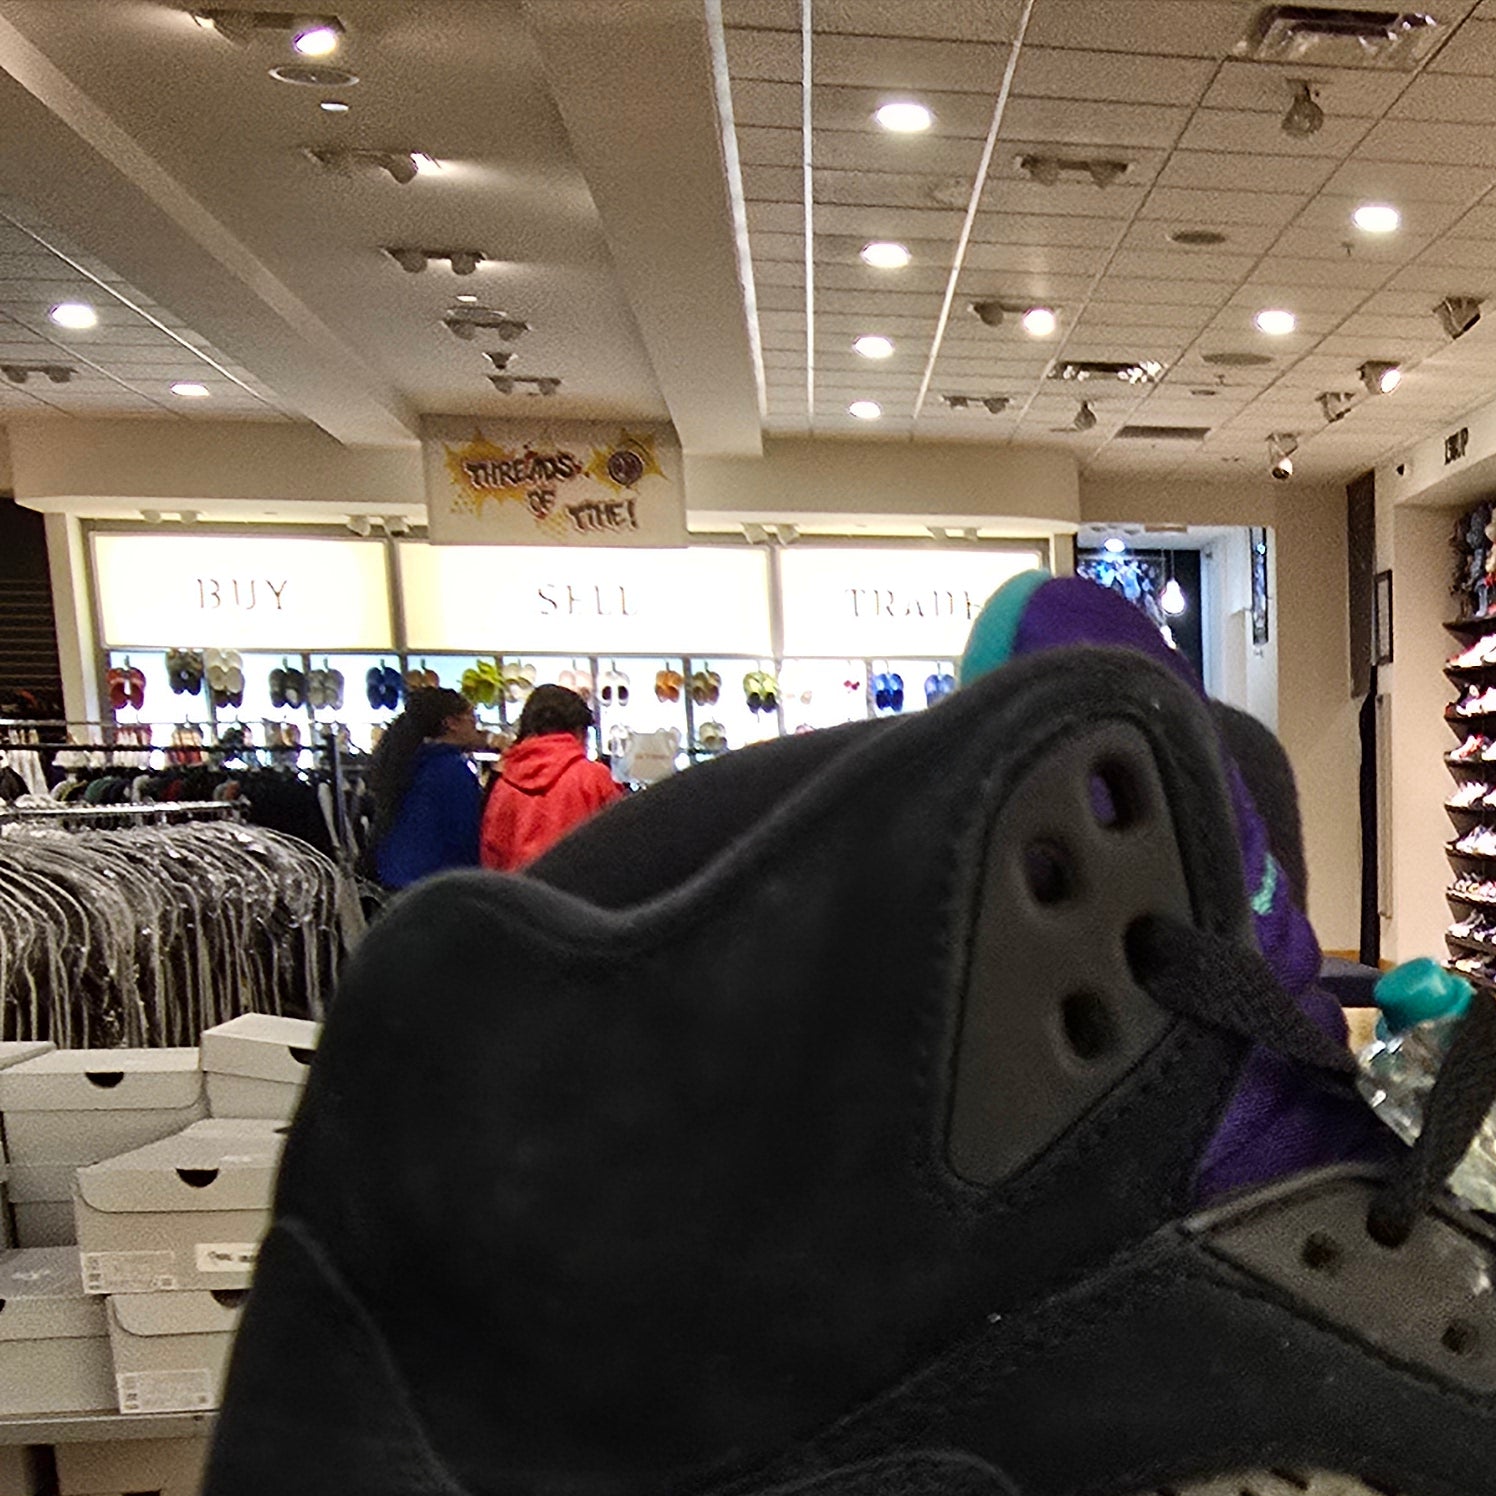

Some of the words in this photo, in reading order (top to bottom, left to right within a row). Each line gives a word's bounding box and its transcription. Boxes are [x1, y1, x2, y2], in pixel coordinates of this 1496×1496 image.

[463, 451, 575, 490] THREADS
[526, 488, 556, 519] OF
[197, 579, 288, 610] BUY
[538, 583, 638, 616] SELL
